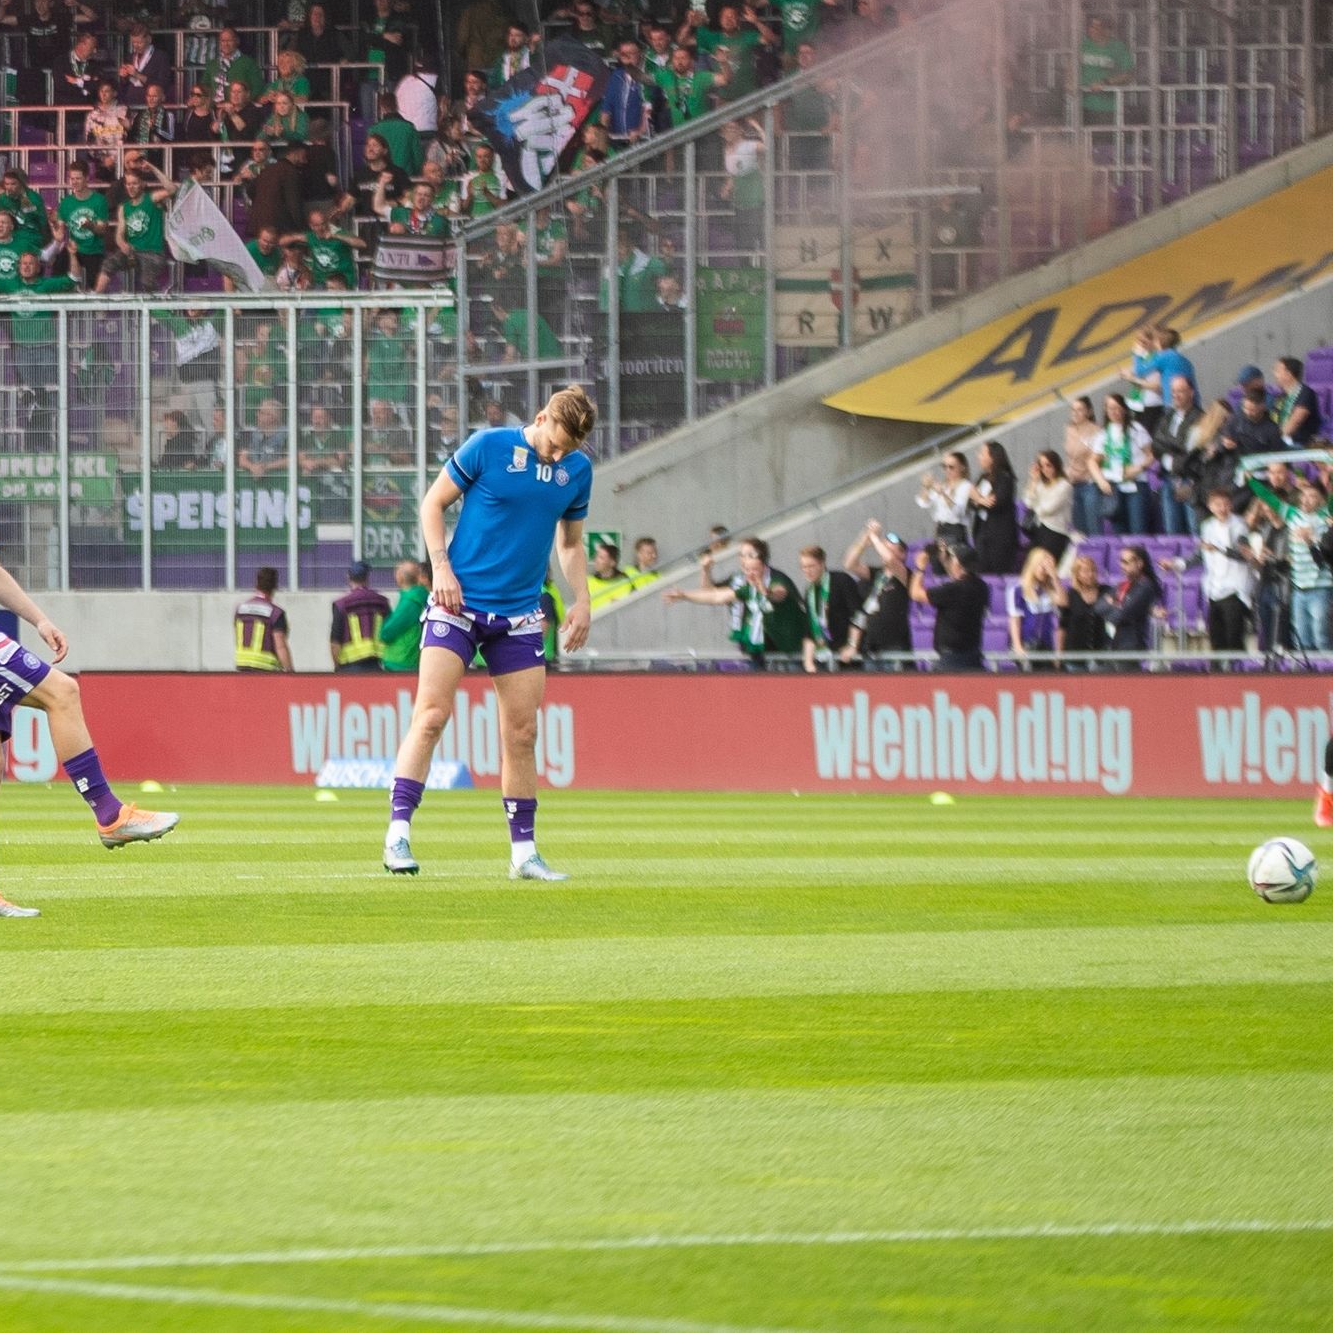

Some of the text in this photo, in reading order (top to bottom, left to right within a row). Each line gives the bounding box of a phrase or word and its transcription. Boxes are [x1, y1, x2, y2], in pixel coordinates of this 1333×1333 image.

[535, 463, 553, 483] 10
[126, 486, 312, 531] SPEISING
[363, 523, 406, 561] DER
